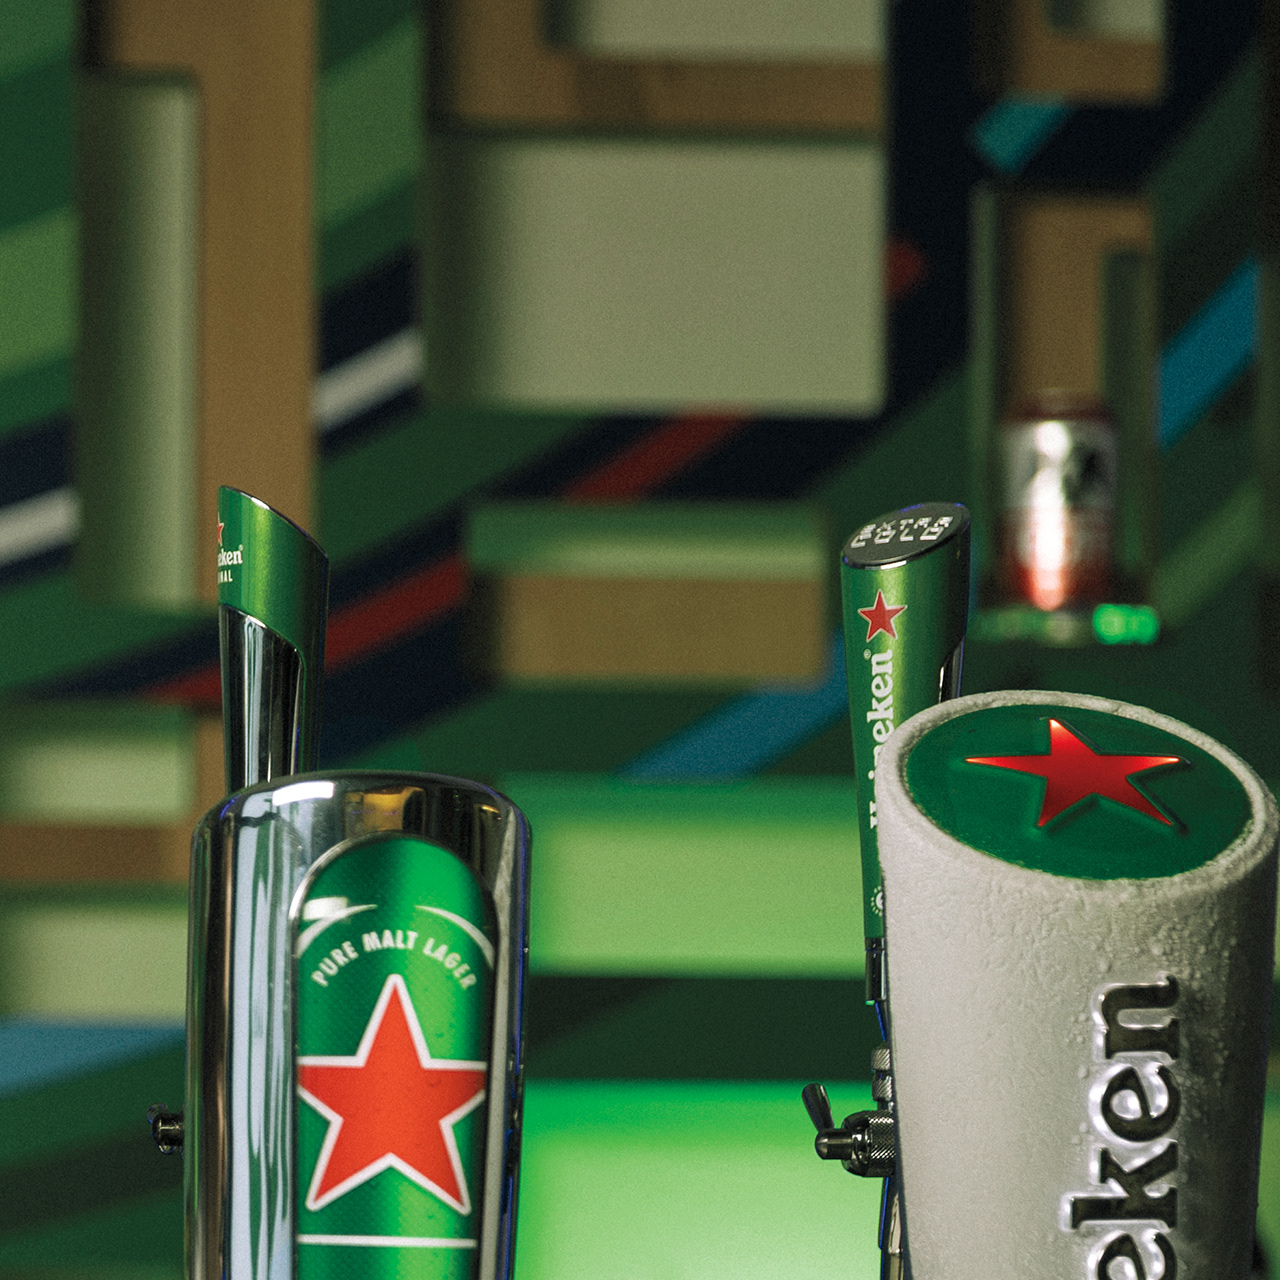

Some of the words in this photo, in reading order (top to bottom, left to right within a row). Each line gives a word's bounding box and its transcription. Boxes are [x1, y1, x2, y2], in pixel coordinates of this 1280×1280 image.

[850, 526, 945, 549] COLD
[860, 516, 953, 540] EXTRA
[310, 940, 359, 988] PURE
[362, 929, 419, 952] MALT
[422, 937, 478, 990] LAGER
